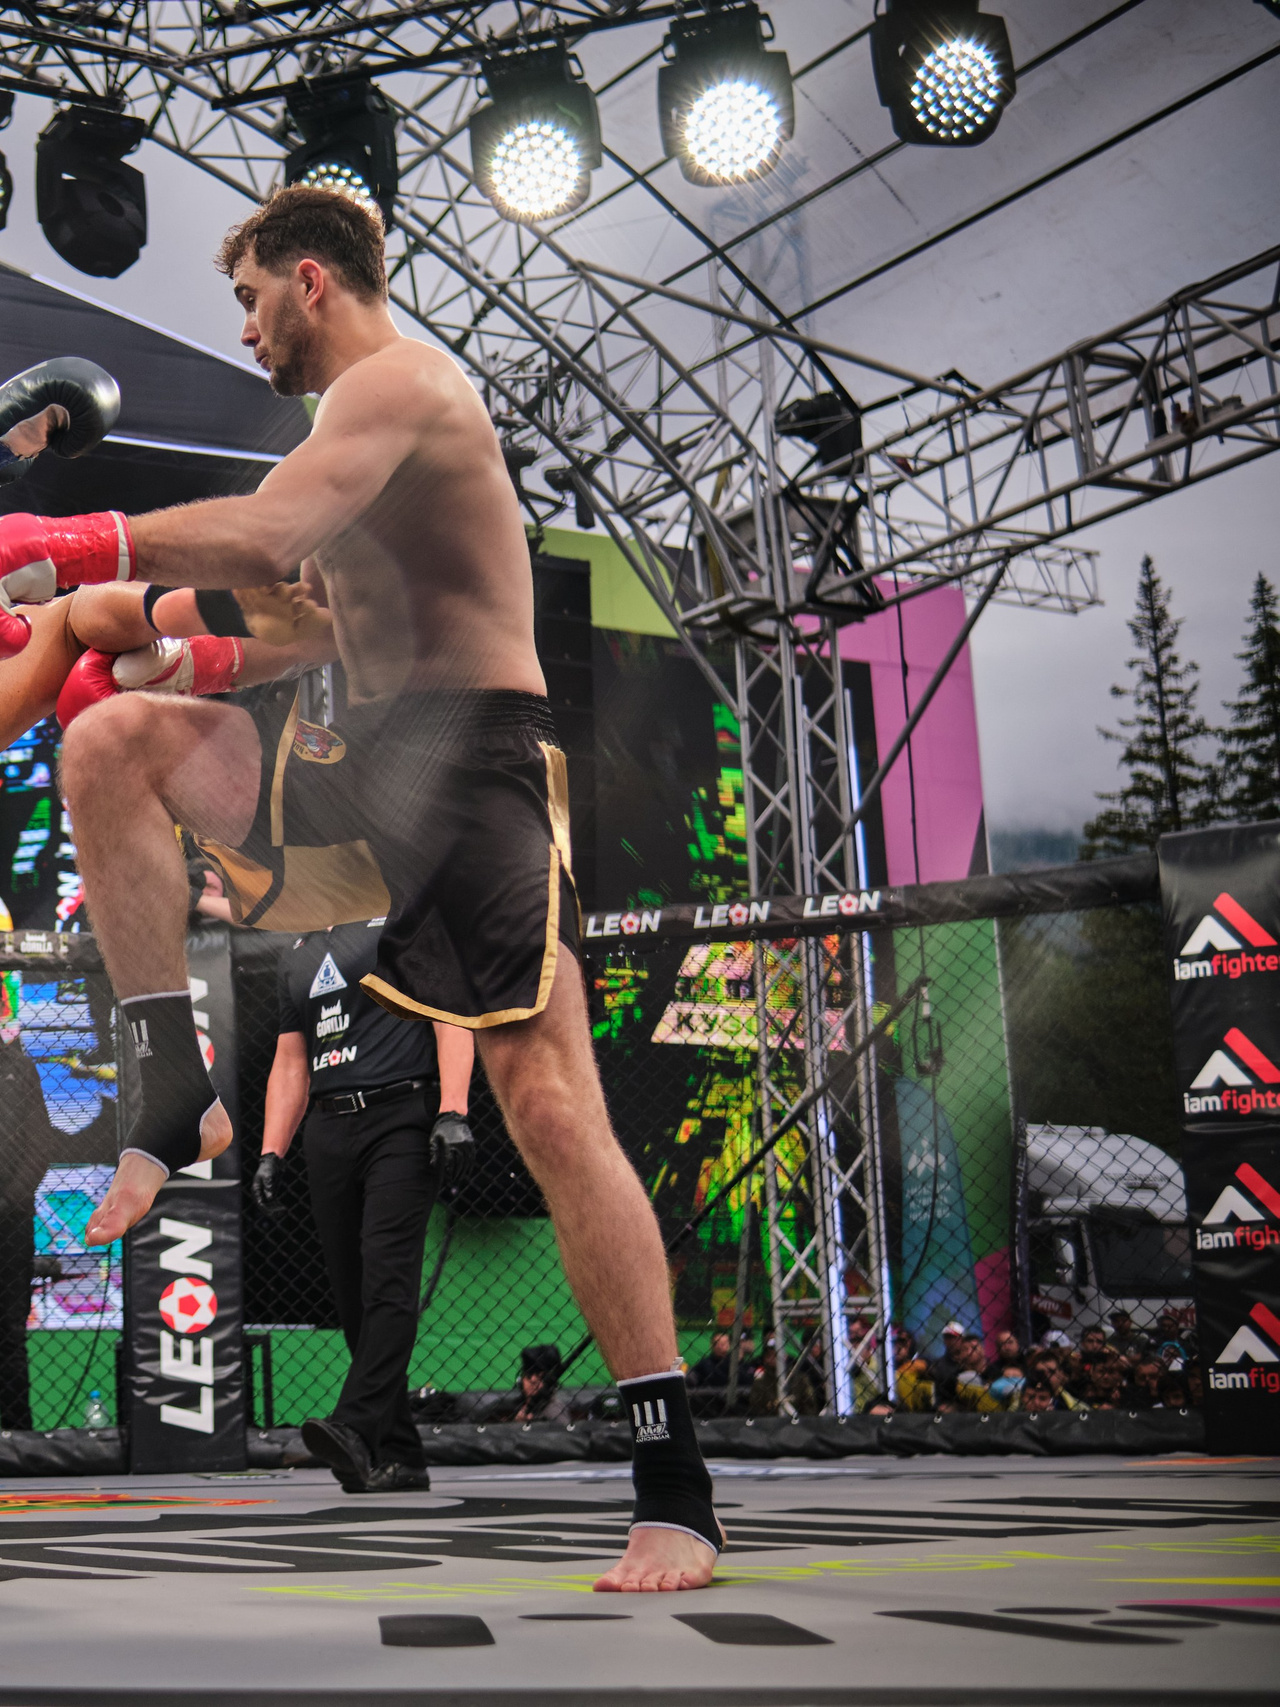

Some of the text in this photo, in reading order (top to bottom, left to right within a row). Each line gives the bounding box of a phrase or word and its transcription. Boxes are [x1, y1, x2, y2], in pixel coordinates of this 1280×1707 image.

[693, 901, 770, 928] LEON
[803, 890, 880, 918] LEON
[586, 910, 662, 937] LEON
[1173, 951, 1280, 981] iamfighte
[316, 1013, 350, 1039] GORILLA
[313, 1045, 357, 1072] LEON
[1196, 1225, 1280, 1251] iamfigh
[159, 1218, 217, 1433] LEON
